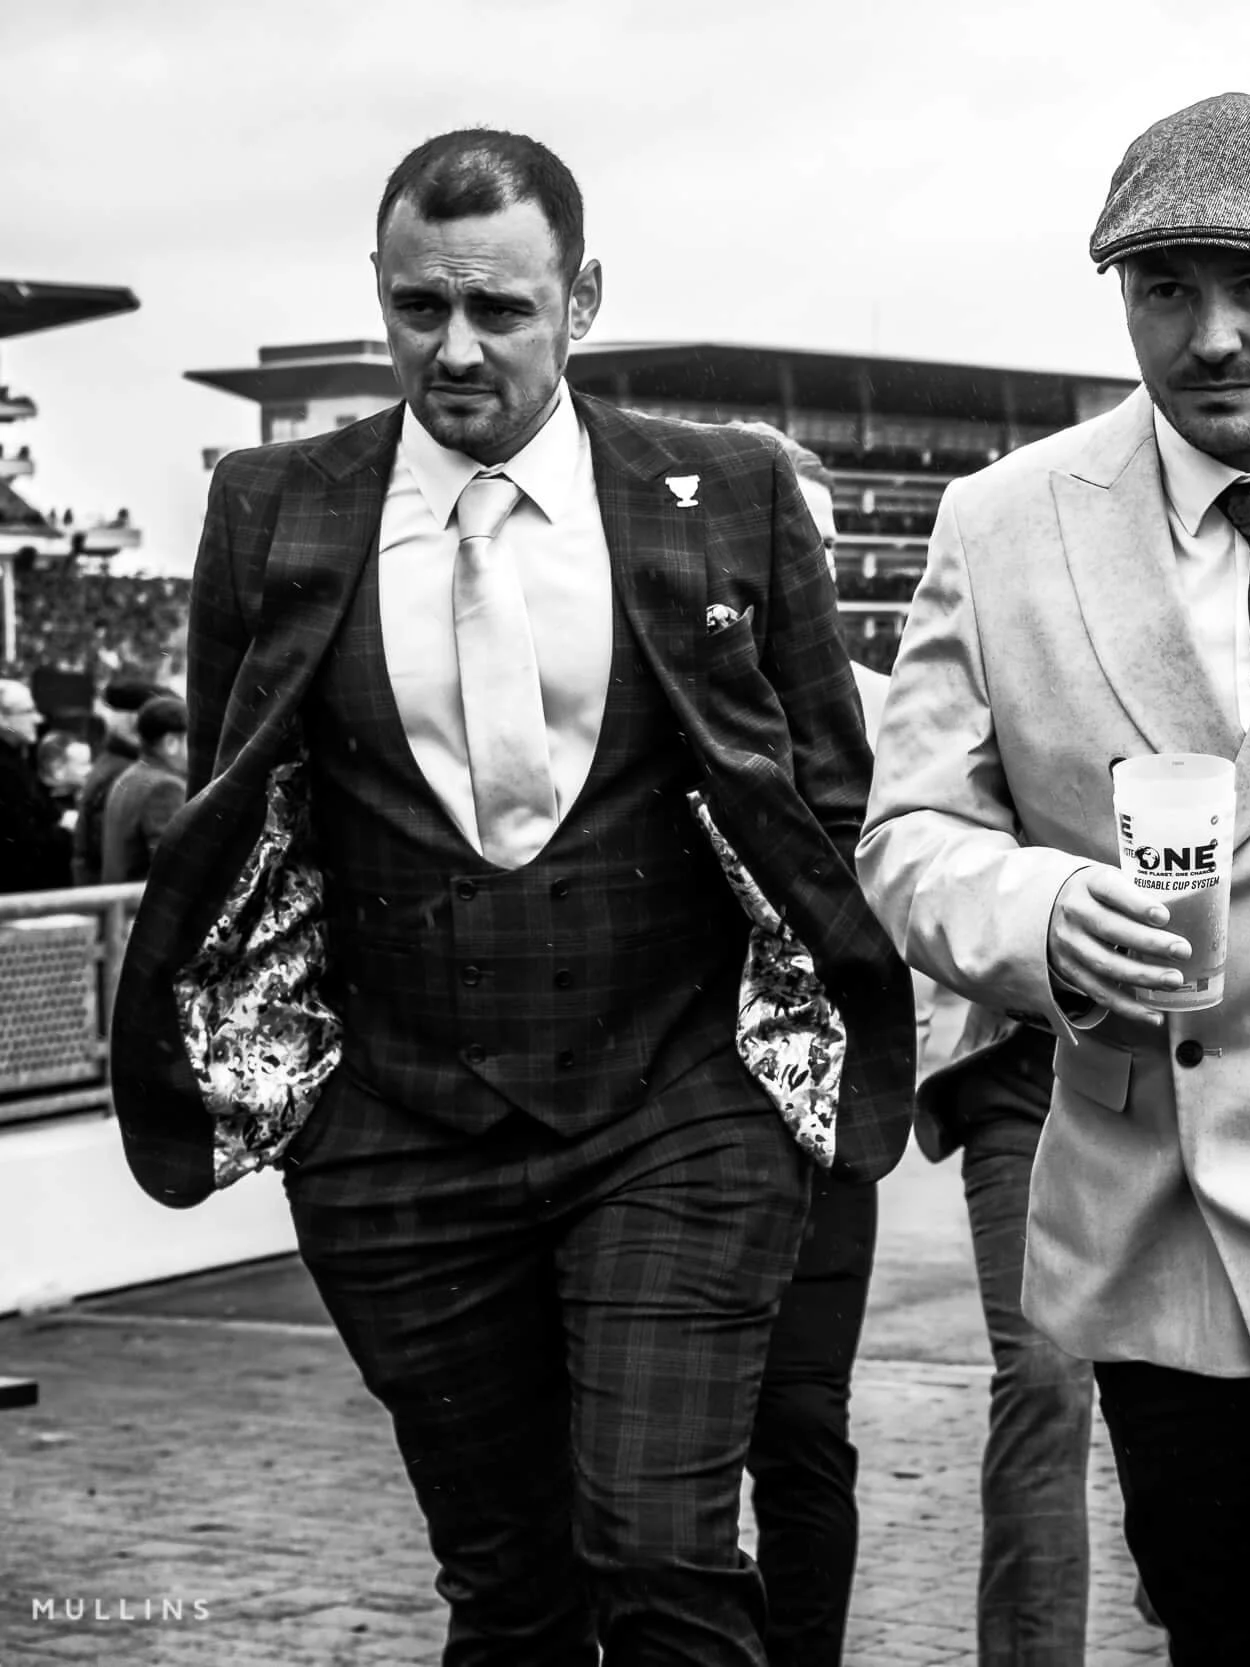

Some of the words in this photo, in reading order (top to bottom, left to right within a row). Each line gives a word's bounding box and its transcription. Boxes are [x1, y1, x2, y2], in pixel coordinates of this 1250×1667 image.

[1139, 844, 1217, 871] ONE
[1134, 877, 1171, 891] REUSABLE
[1172, 880, 1190, 891] CUP
[1191, 875, 1220, 890] SYSTEM
